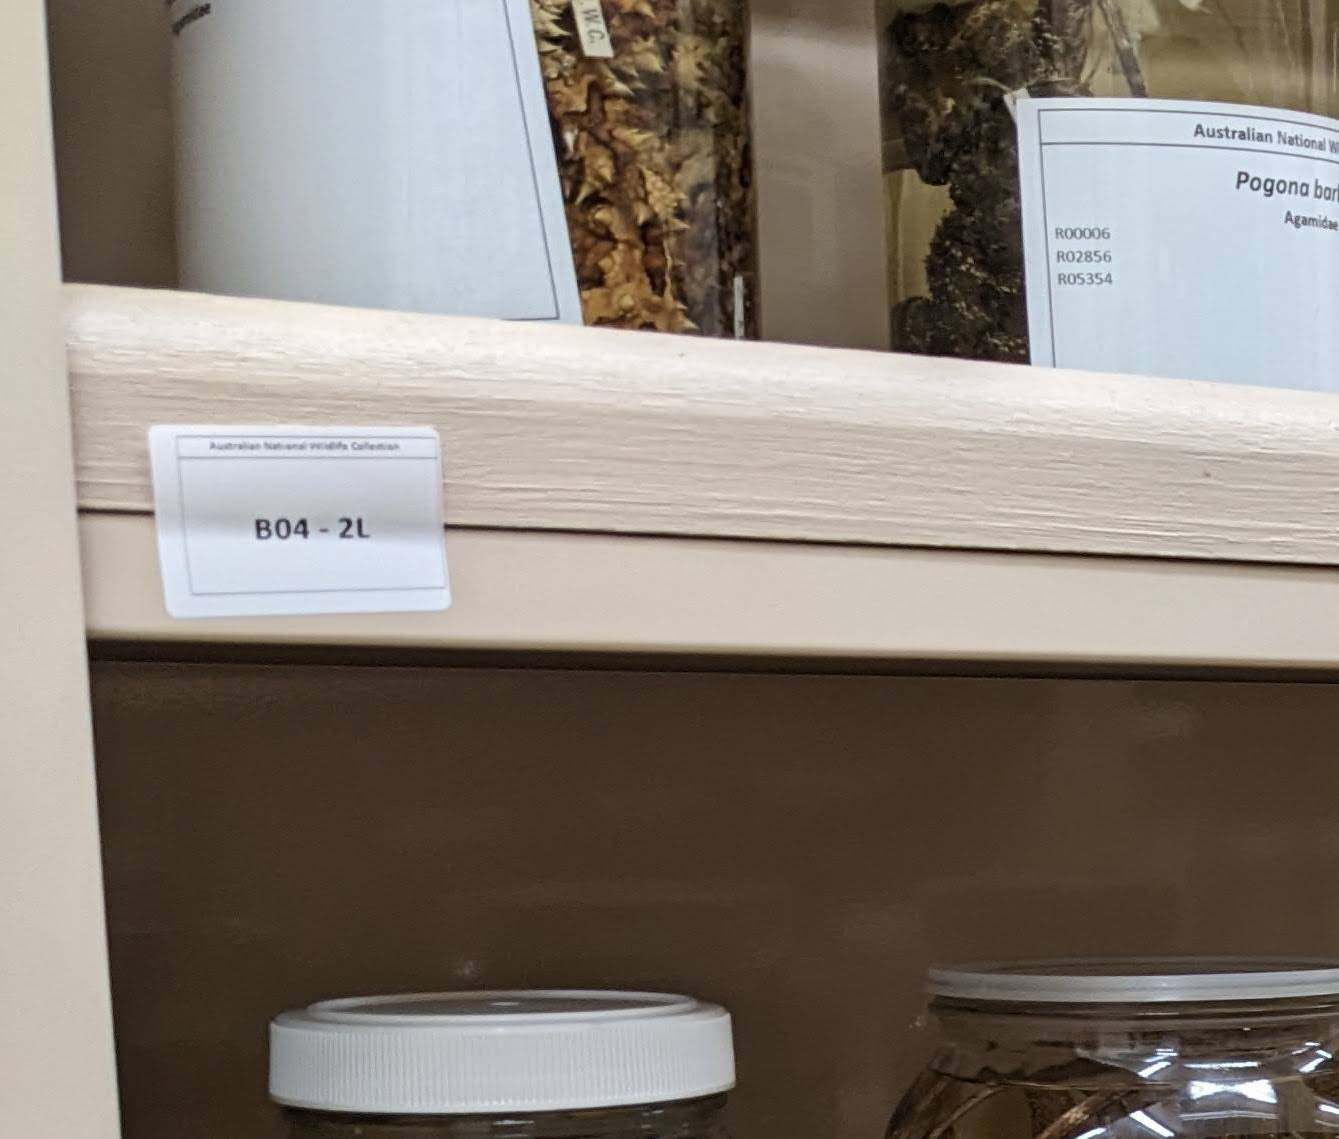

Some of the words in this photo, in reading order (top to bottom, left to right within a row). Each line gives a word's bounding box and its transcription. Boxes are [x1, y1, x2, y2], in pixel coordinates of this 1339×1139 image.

[1194, 123, 1273, 143] Australian
[1278, 132, 1326, 152] National
[1235, 171, 1309, 198] Pogona
[1284, 210, 1338, 232] Agamidae
[1055, 228, 1110, 240] R00006
[1056, 251, 1112, 263] R02856
[1058, 273, 1112, 286] R05354
[210, 441, 260, 450] Australian
[264, 442, 306, 450] National
[310, 442, 348, 450] Wildlife
[351, 442, 400, 450] Collection
[255, 518, 309, 540] B04
[338, 518, 370, 538] 2L
